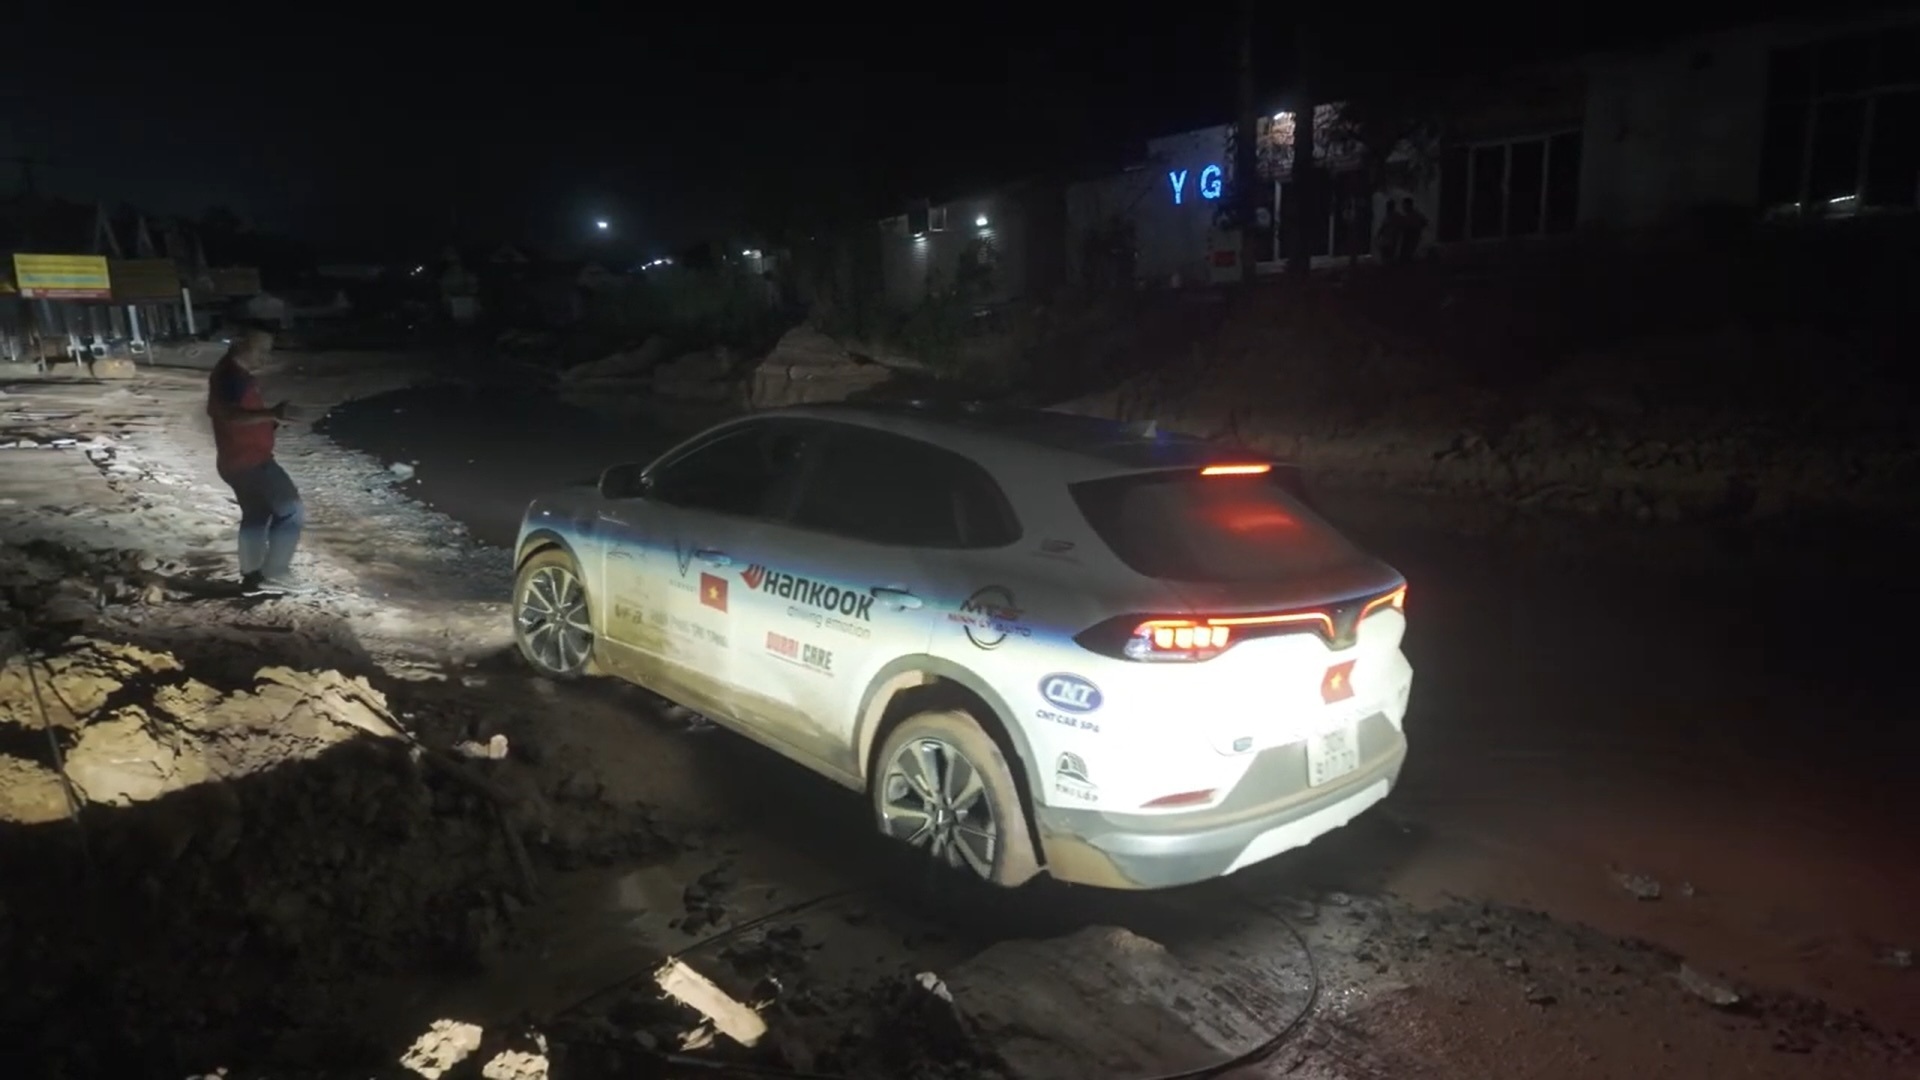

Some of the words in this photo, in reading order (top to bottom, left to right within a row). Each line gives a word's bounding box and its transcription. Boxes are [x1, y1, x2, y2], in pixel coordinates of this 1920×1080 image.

[825, 617, 871, 640] emotion
[802, 643, 832, 670] CARE
[1046, 679, 1095, 709] CNT
[1035, 709, 1056, 722] CNT
[1056, 714, 1078, 728] CAR
